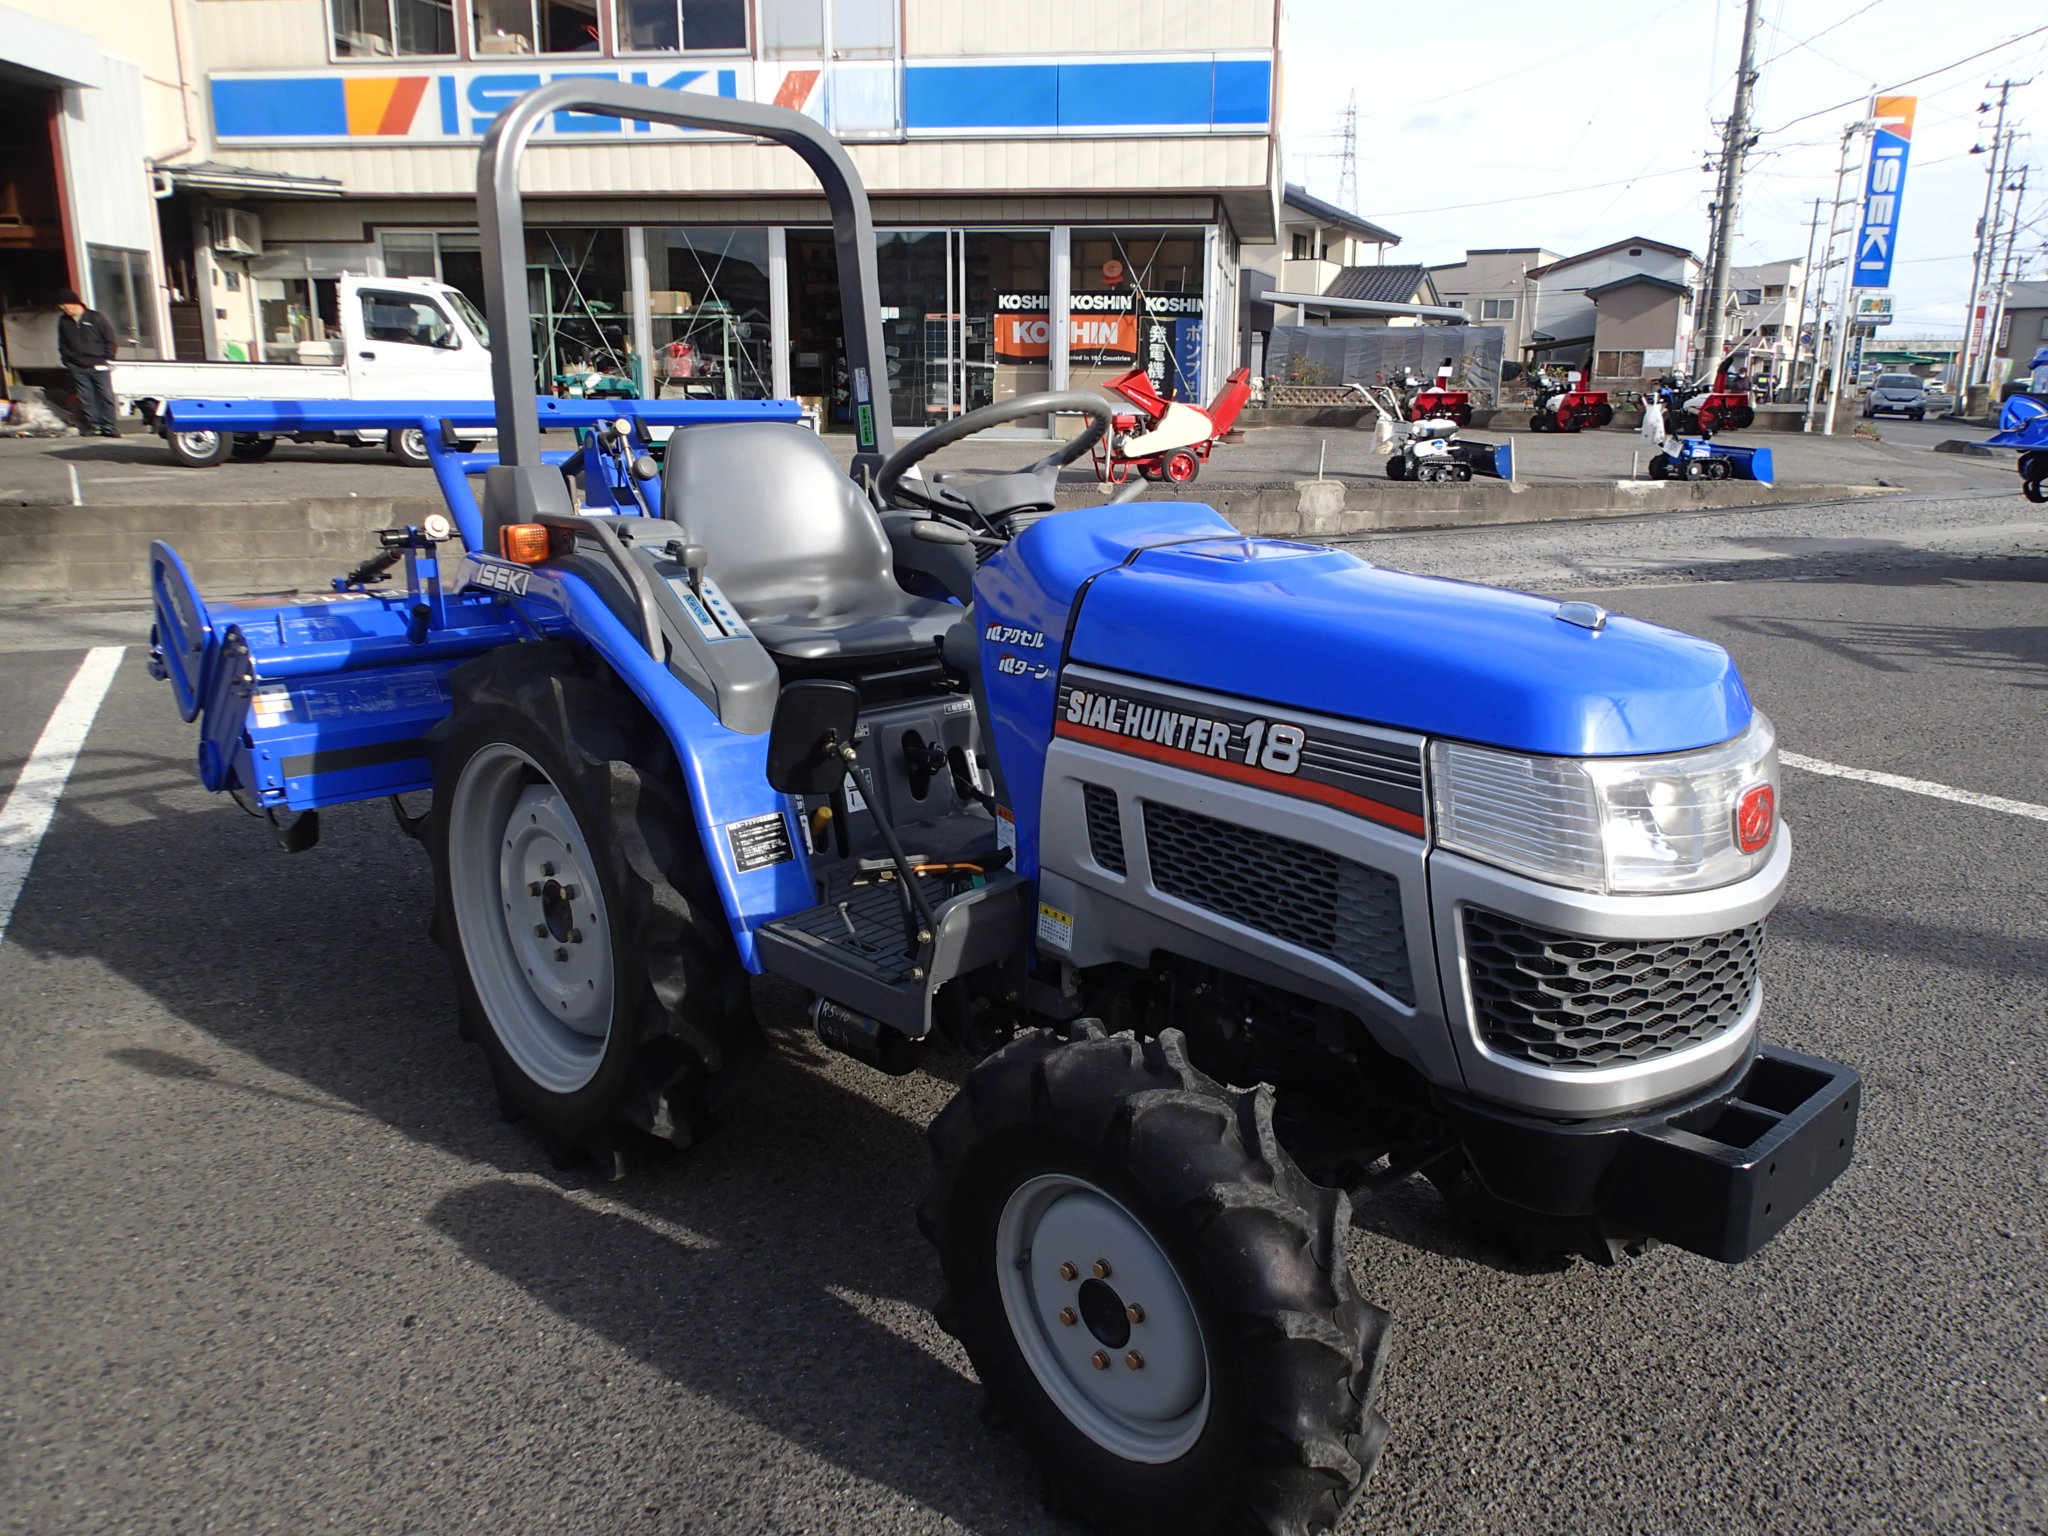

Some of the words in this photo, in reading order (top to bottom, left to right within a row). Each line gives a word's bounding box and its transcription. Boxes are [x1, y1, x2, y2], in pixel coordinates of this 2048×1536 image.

[1859, 147, 1903, 270] ISEKI
[998, 294, 1049, 309] KOSHI
[1070, 294, 1132, 310] KOSHIN
[1012, 320, 1118, 344] KOHIN
[1148, 325, 1167, 396] 発電機は
[476, 563, 530, 596] ISEKI
[1241, 719, 1306, 775] 18
